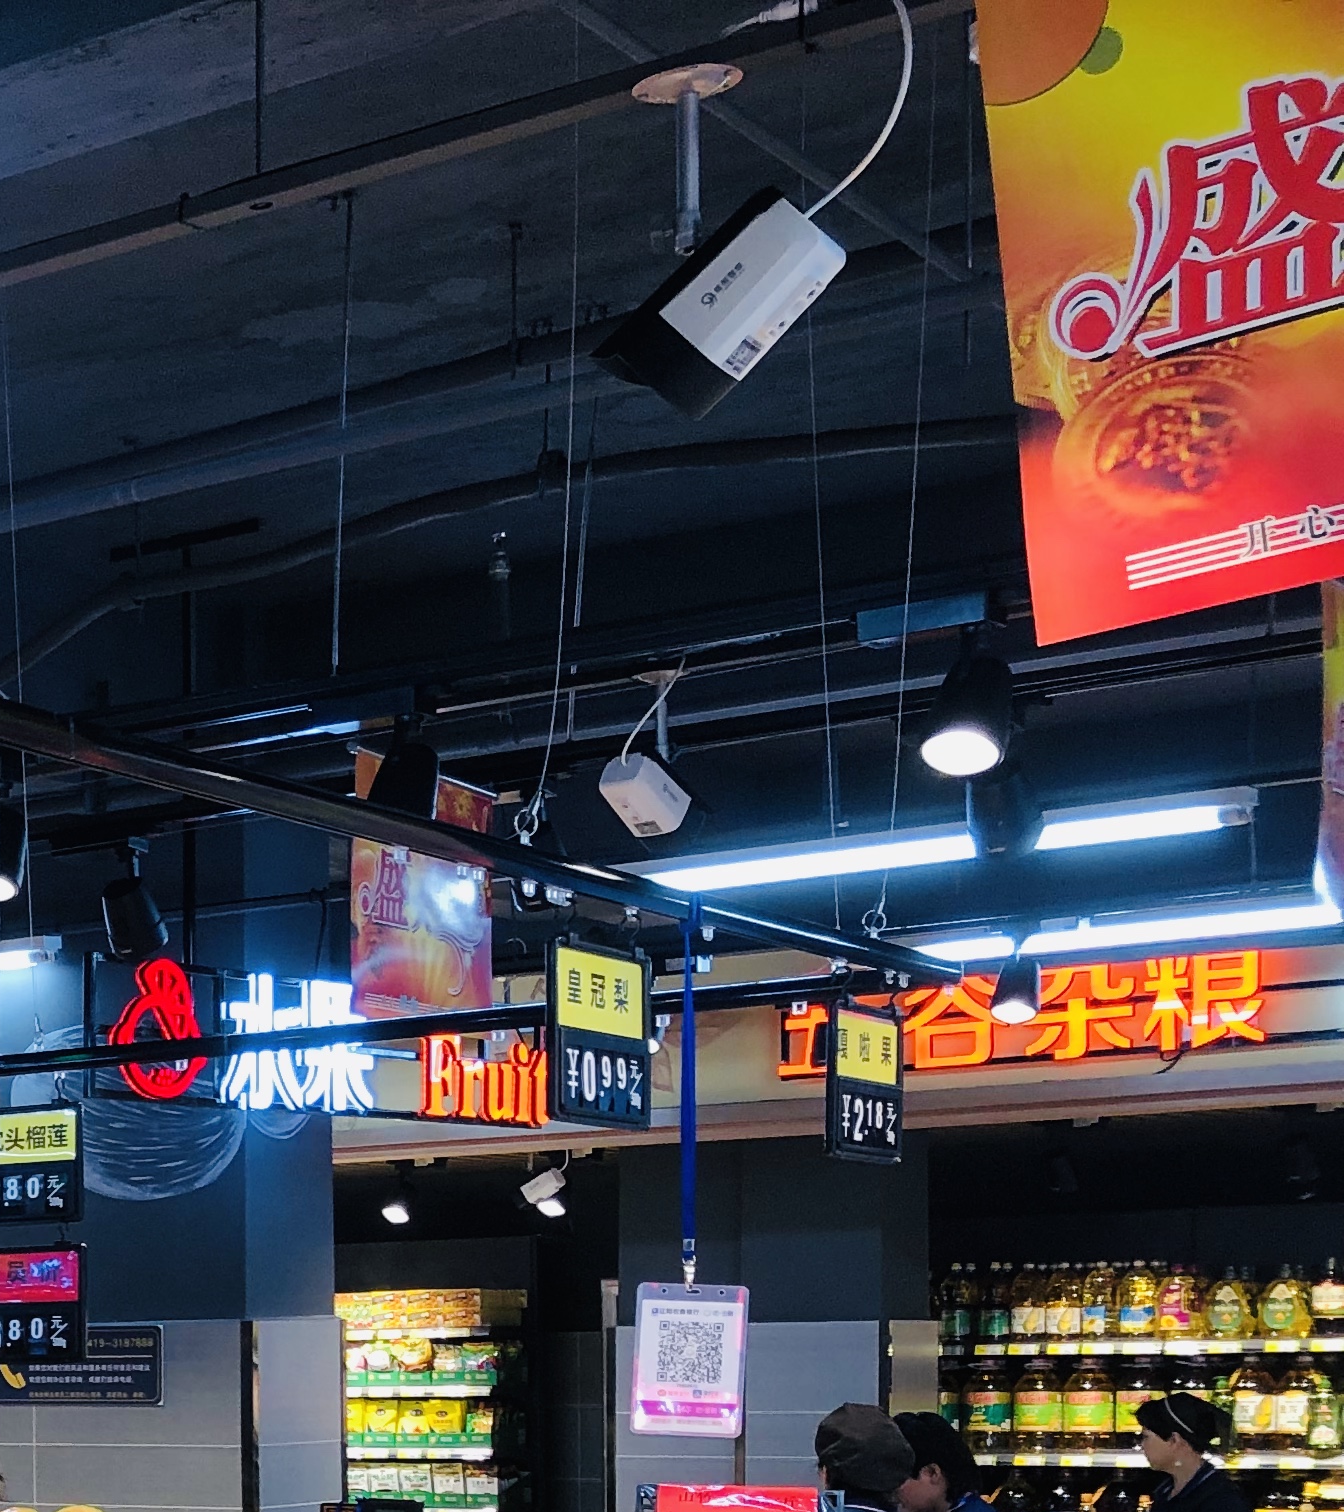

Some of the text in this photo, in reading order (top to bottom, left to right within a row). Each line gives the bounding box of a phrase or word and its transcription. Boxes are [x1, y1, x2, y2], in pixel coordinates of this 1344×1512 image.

[1239, 503, 1336, 558] 开心
[566, 967, 629, 1014] 皇冠梨
[777, 950, 1266, 1077] 五谷杂粮
[219, 972, 549, 1125] 水果 Fruit
[565, 1047, 627, 1102] ¥0.99
[841, 1093, 884, 1142] ¥2.18
